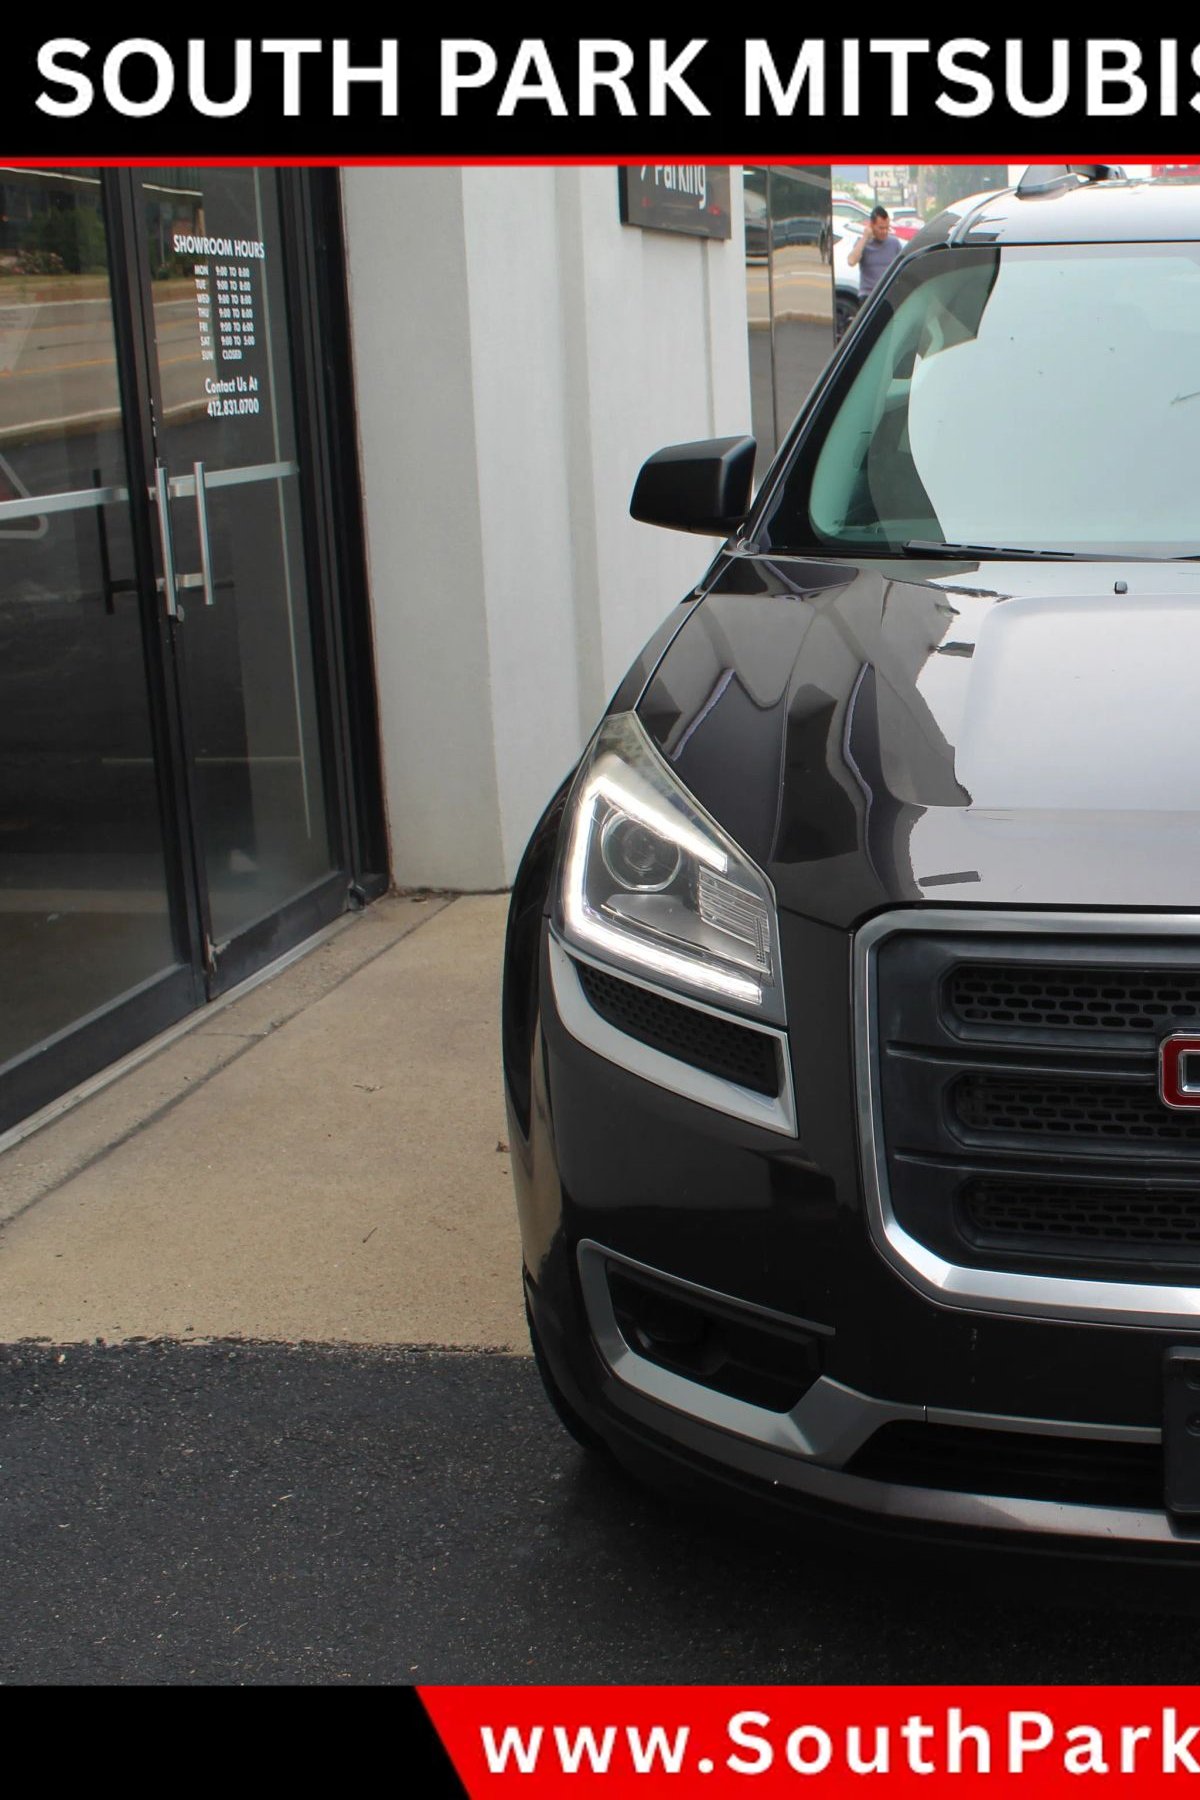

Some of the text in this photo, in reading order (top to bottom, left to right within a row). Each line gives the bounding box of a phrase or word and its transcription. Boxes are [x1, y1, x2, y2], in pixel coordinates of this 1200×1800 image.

[173, 234, 265, 259] SHOWROOM HOURS
[229, 266, 237, 278] TO
[230, 280, 238, 291] TO
[231, 294, 239, 305] TO
[232, 307, 240, 319] TO
[233, 321, 241, 333] TO
[233, 335, 241, 346] TO
[222, 349, 242, 360] CLOSED
[204, 375, 258, 394] Contact Us At
[206, 398, 260, 417] 412.831.0700
